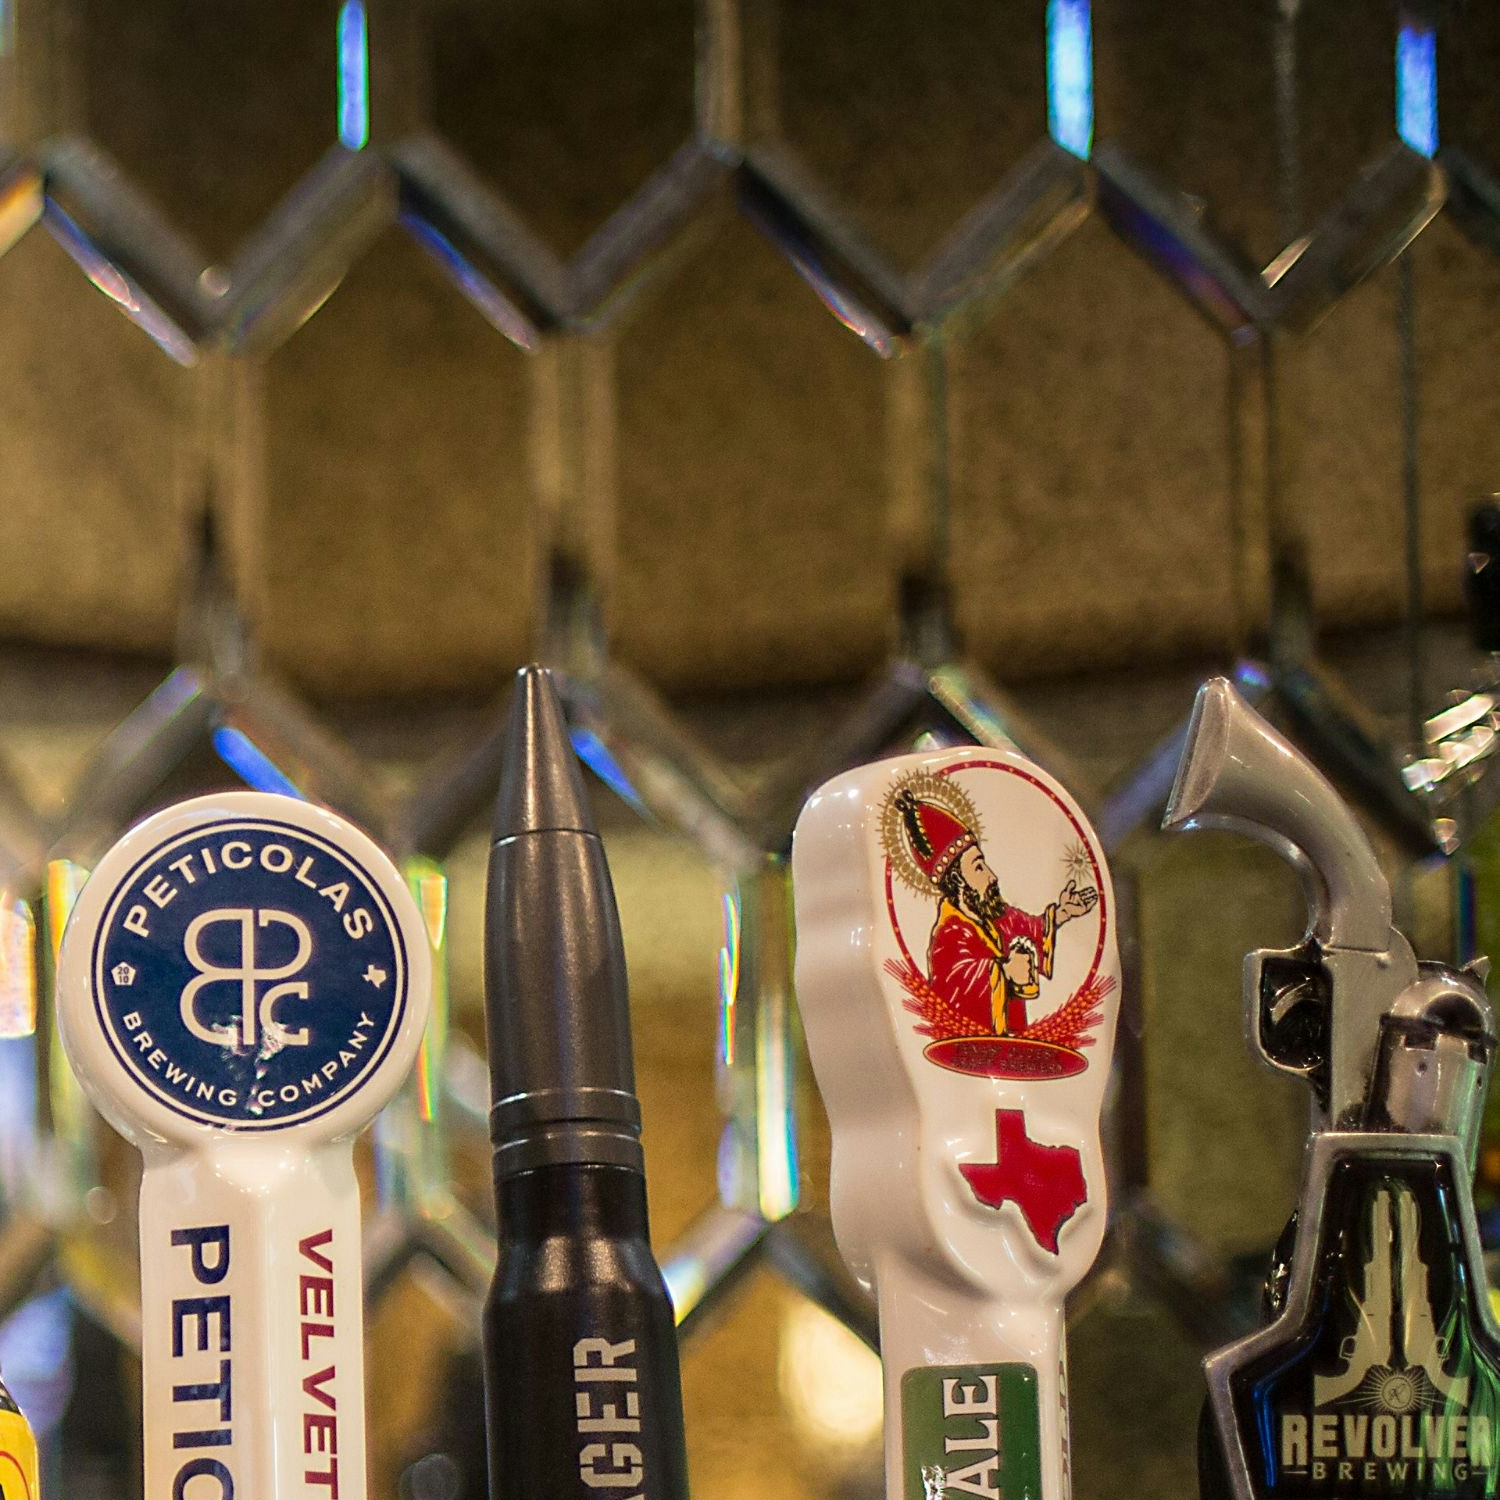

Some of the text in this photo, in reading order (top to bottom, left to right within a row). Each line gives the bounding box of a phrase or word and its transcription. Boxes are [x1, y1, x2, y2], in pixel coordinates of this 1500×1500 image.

[122, 841, 374, 941] PETICOLAS
[123, 1011, 377, 1107] BREWING COMPANY
[298, 1227, 340, 1500] VELVET
[1280, 1413, 1496, 1467] REVOLVER
[1312, 1461, 1469, 1482] BREWING
